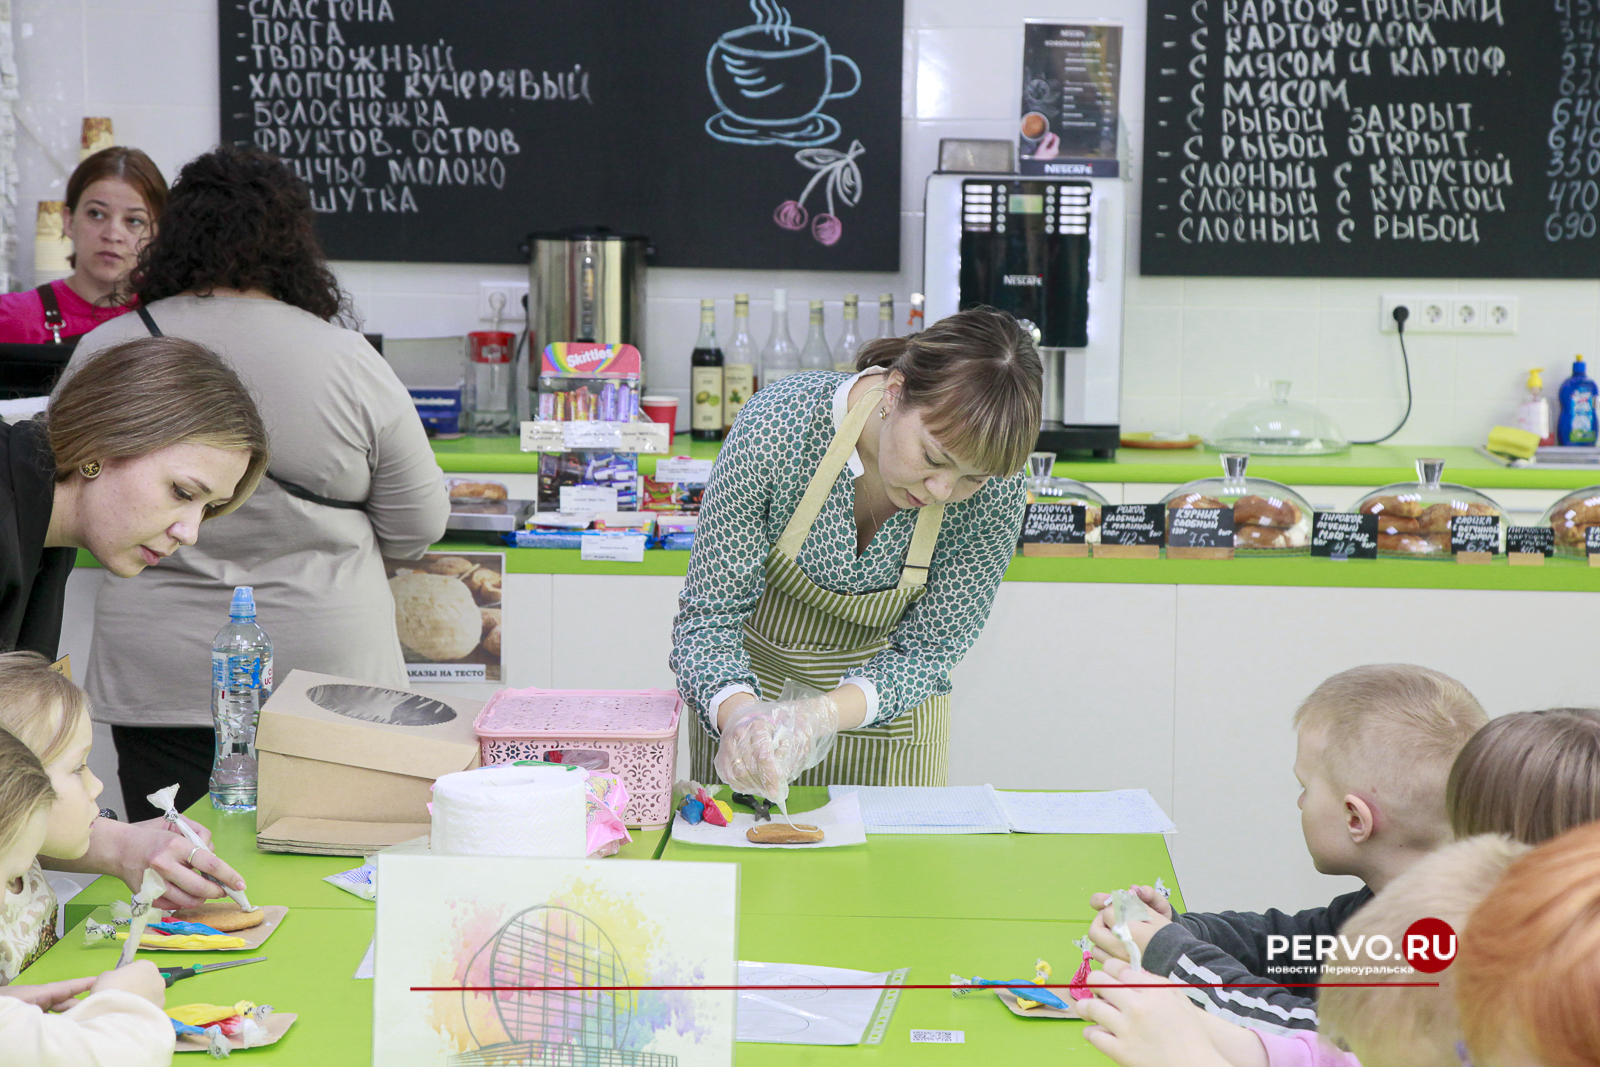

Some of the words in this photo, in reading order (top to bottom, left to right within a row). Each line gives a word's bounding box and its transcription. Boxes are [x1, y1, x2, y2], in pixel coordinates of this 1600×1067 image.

[1191, 0, 1208, 24] С
[252, 18, 346, 46] ПРАГА
[1191, 27, 1208, 51] С
[250, 39, 455, 72] ТВОРОЖНЫЙ
[1188, 53, 1207, 78] С
[1224, 50, 1336, 79] МЯСОМ
[1349, 50, 1371, 76] И
[249, 71, 387, 99] ХЛОПЧИК
[405, 64, 593, 104] КУЧЕРЯВЫЙ
[1190, 82, 1205, 107] С
[1223, 79, 1350, 111] МЯСОМ
[254, 99, 449, 127] БЕЛОСНЕЖКА
[1187, 107, 1205, 131] С
[1222, 108, 1324, 133] РЫБОЙ
[253, 127, 401, 157] ФРУКТОВ.
[412, 126, 520, 154] ОСТРОВ
[1184, 135, 1203, 160] С
[1222, 133, 1328, 160] РЫБОЙ
[388, 156, 505, 189] МОЛОКО
[1180, 160, 1316, 189] СЛОЕНЫЙ
[1333, 161, 1352, 188] С
[1369, 153, 1513, 186] КАПУСТОЙ
[1547, 149, 1600, 177] 350
[1179, 186, 1318, 216] СЛОЕНЫЙ
[1336, 189, 1351, 215] С
[1370, 184, 1505, 212] КУРАГОЙ
[1548, 180, 1599, 211] 470
[1178, 216, 1320, 245] СЛОЕНЫЙ
[1337, 218, 1355, 243] С
[1374, 213, 1480, 246] РЫБОЙ
[1545, 211, 1597, 241] 690
[566, 348, 614, 368] Skittles
[1030, 504, 1072, 514] БУЛОЧКА
[1116, 505, 1147, 516] РОЖОК
[1175, 509, 1220, 520] КУРНИК
[1321, 513, 1363, 523] ПИРОЖОК
